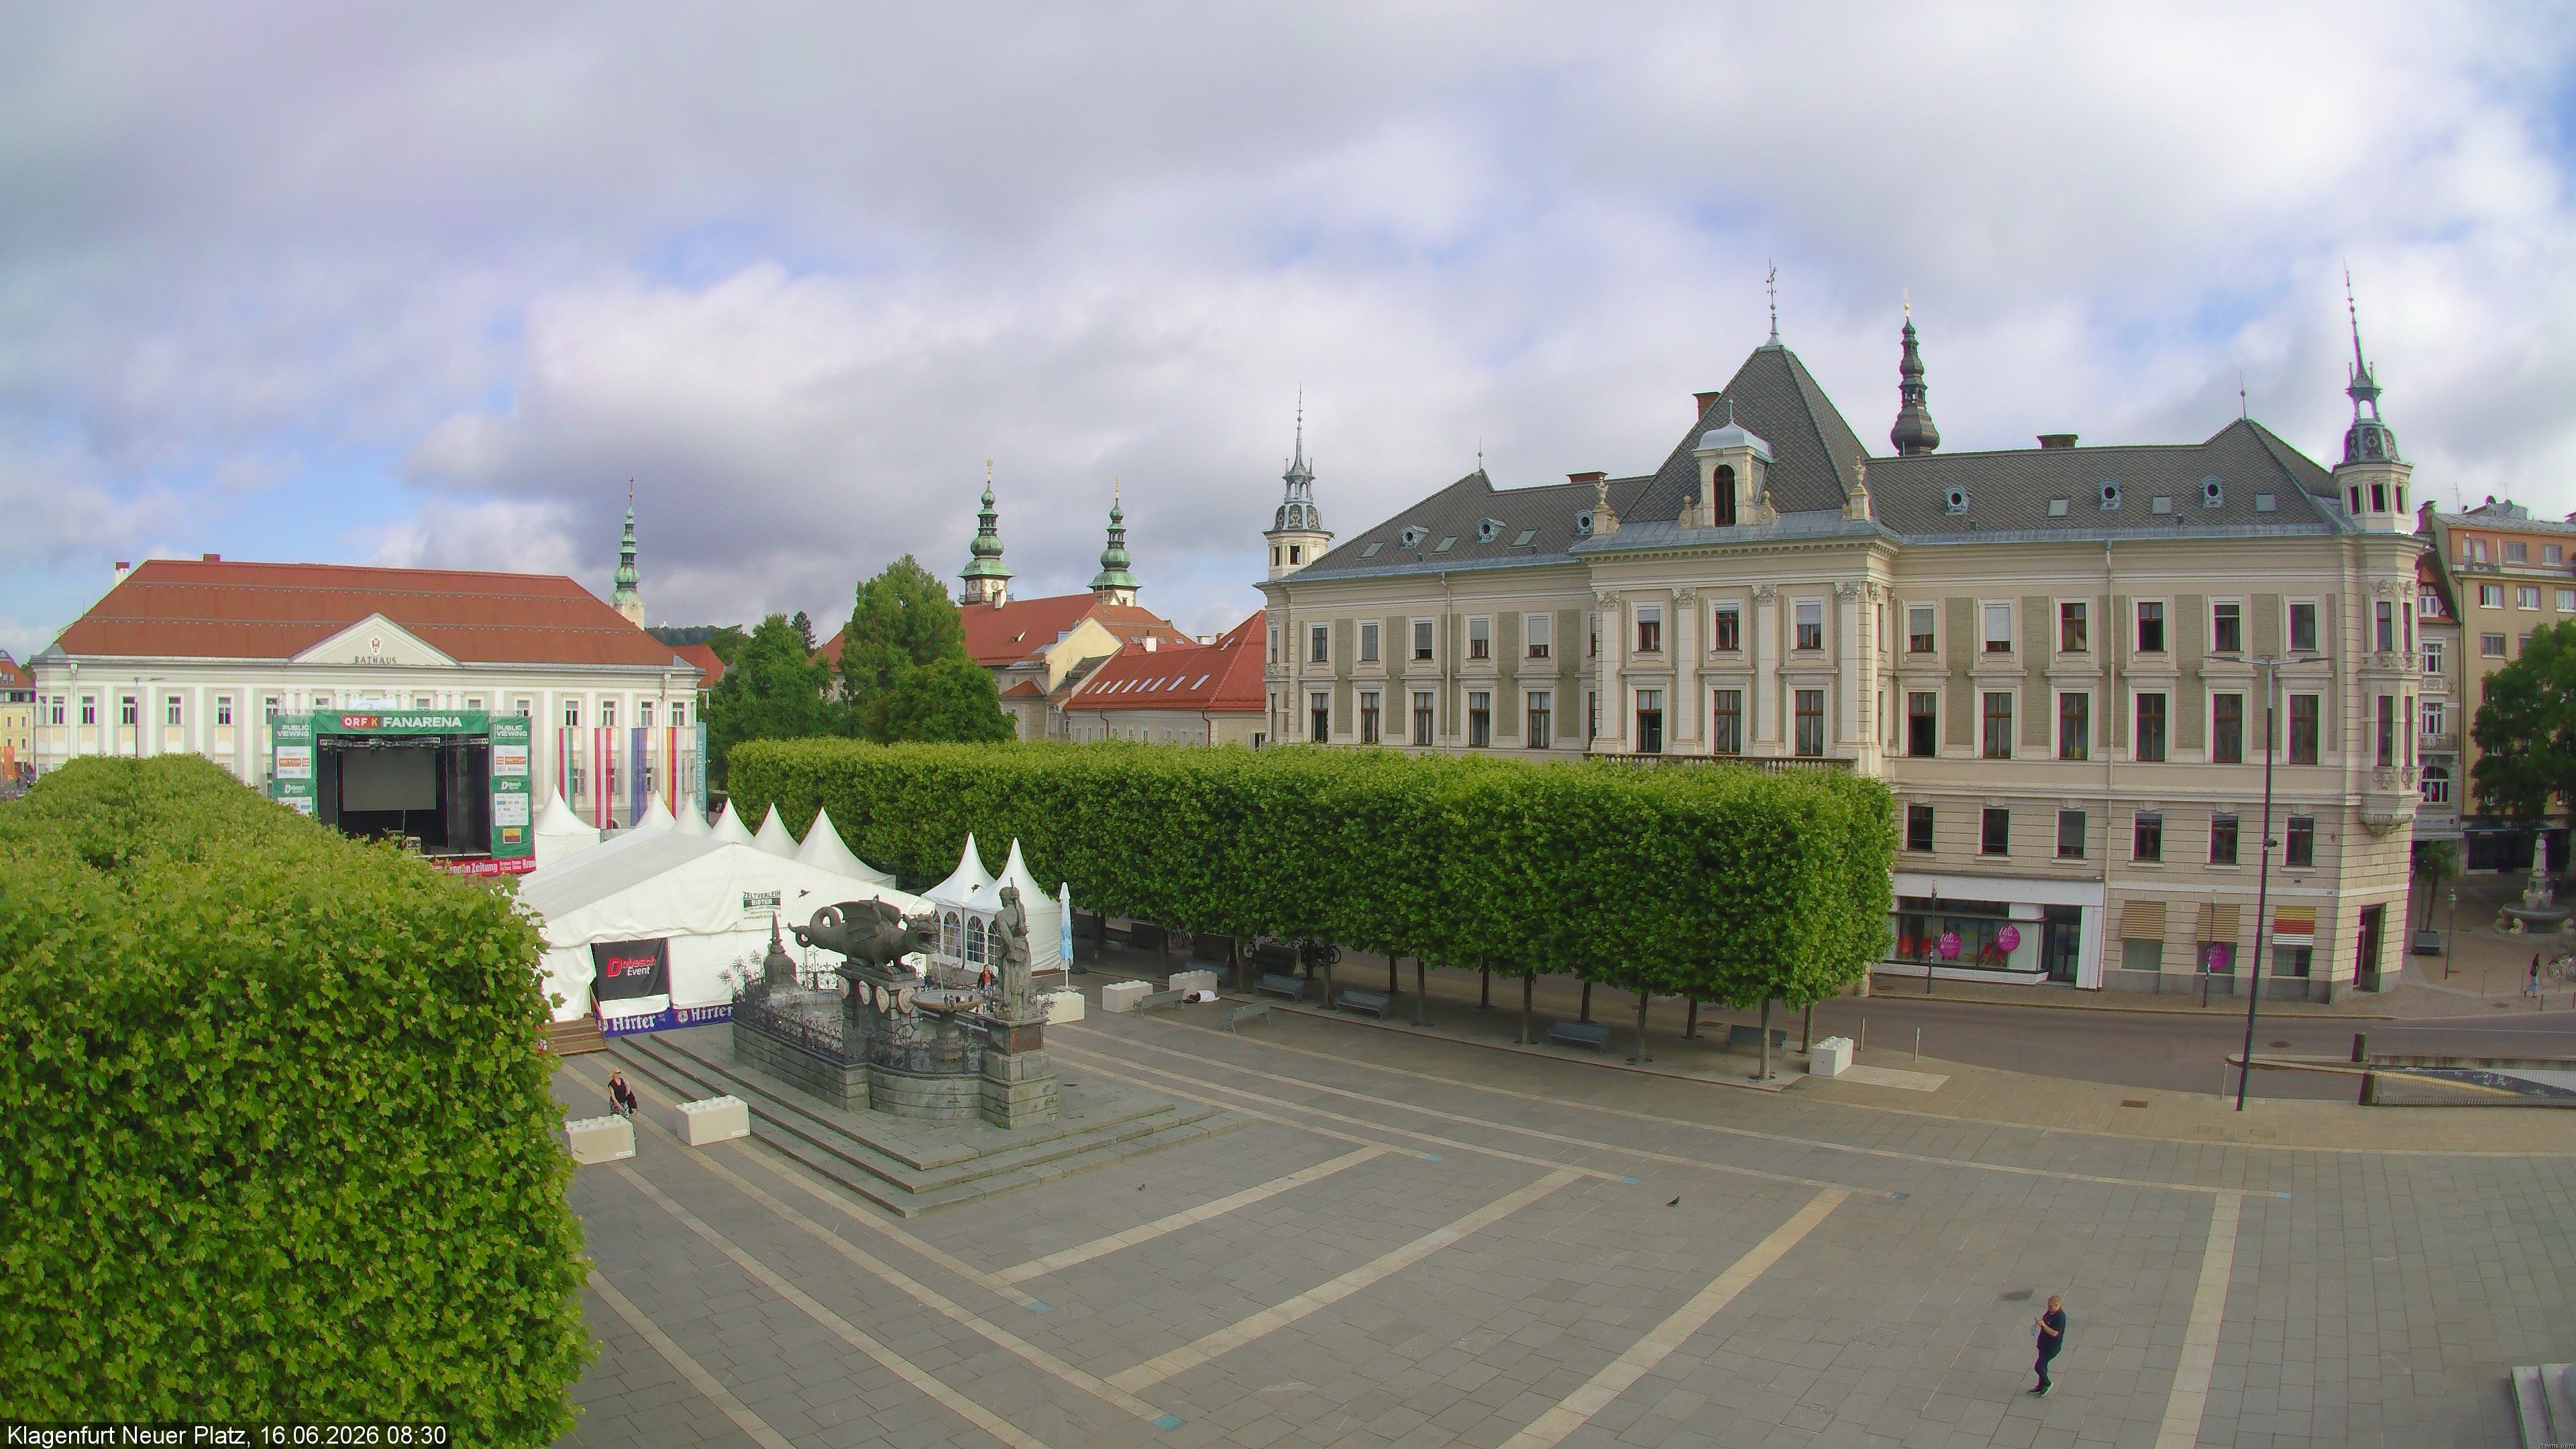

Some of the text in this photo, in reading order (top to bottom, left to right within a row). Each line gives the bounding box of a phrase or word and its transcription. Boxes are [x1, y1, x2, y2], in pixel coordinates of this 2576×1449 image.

[355, 655, 397, 665] RATHAUS
[345, 716, 463, 727] ORF K FANARENA
[472, 861, 498, 873] Zeitung
[743, 889, 781, 898] ZELTVERLEIH
[627, 966, 650, 977] Event
[691, 1006, 733, 1021] Hirter
[612, 1014, 656, 1031] Hirter
